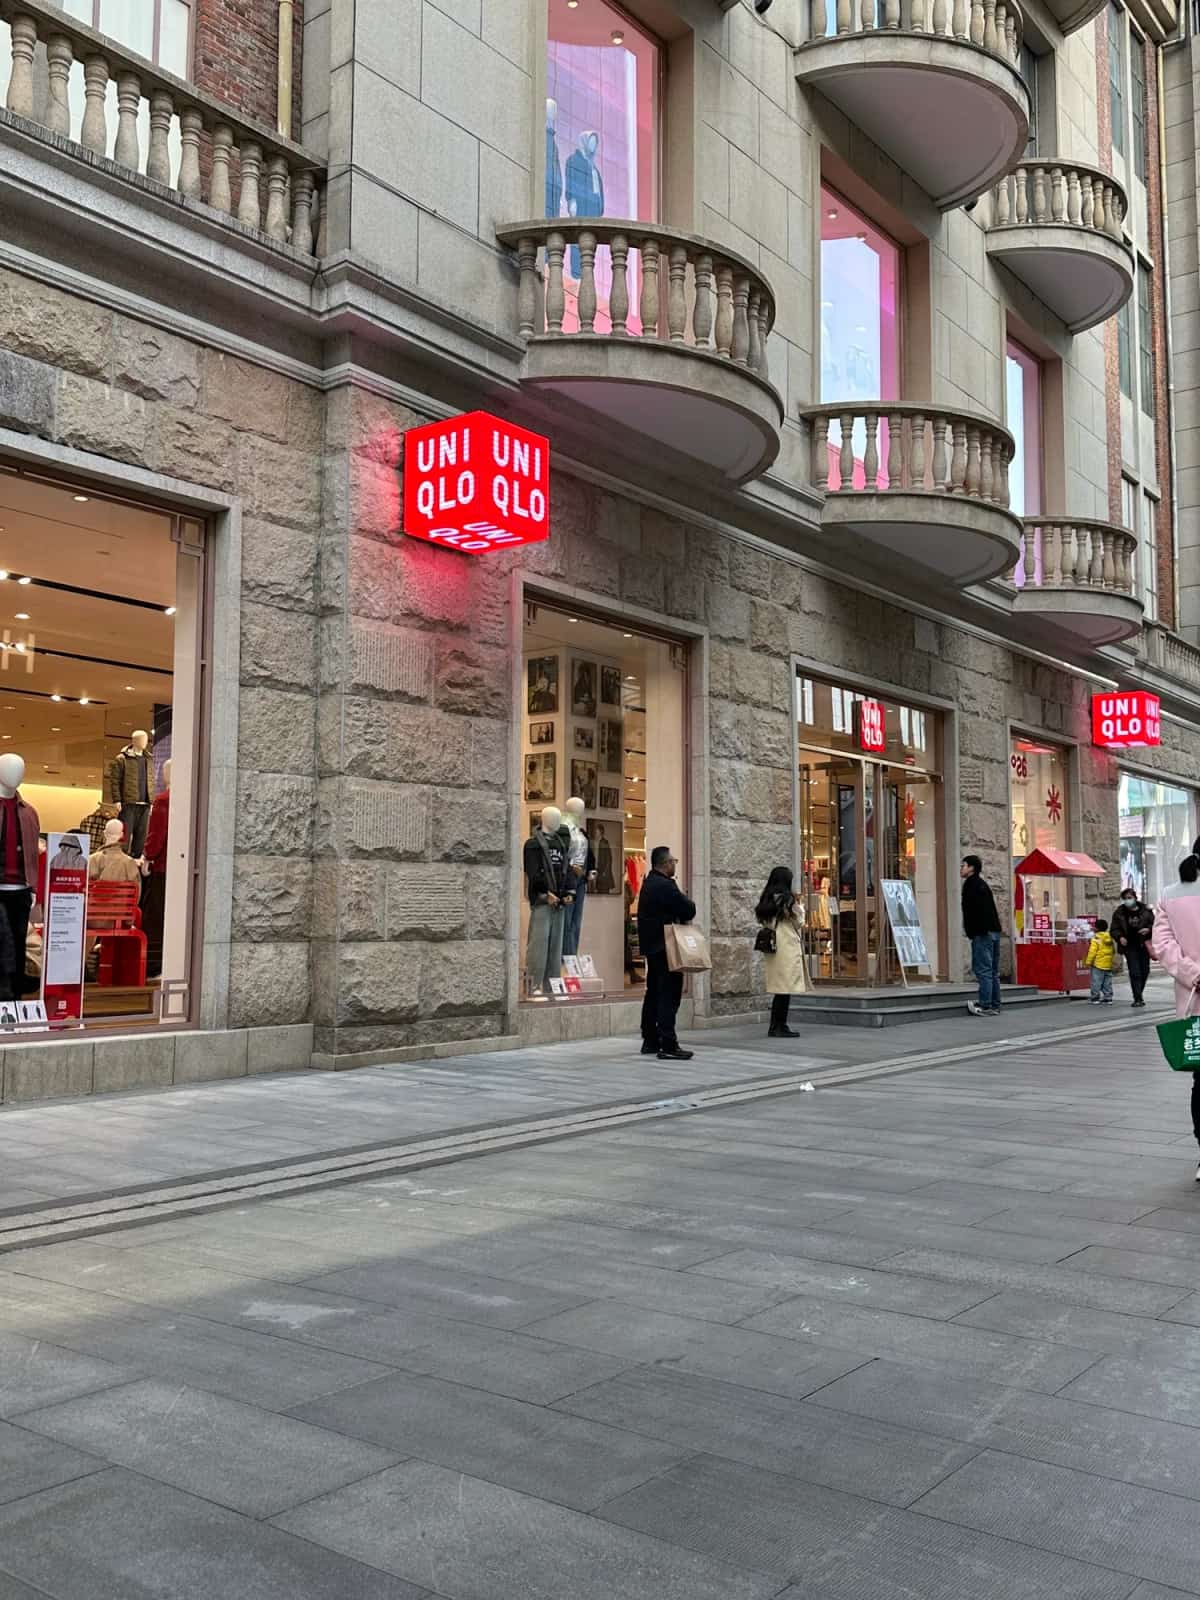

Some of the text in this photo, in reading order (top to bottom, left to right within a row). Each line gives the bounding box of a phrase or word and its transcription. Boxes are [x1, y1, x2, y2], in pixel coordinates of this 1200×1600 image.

[417, 428, 470, 472] UNI
[493, 430, 541, 481] UNI
[417, 470, 475, 520] QLO
[492, 475, 545, 522] QLO
[428, 527, 491, 549] QLO
[463, 521, 524, 543] UNI
[863, 707, 881, 727] UNI
[1101, 697, 1137, 717] UNI
[864, 728, 883, 748] QLO
[1101, 717, 1141, 739] QLO
